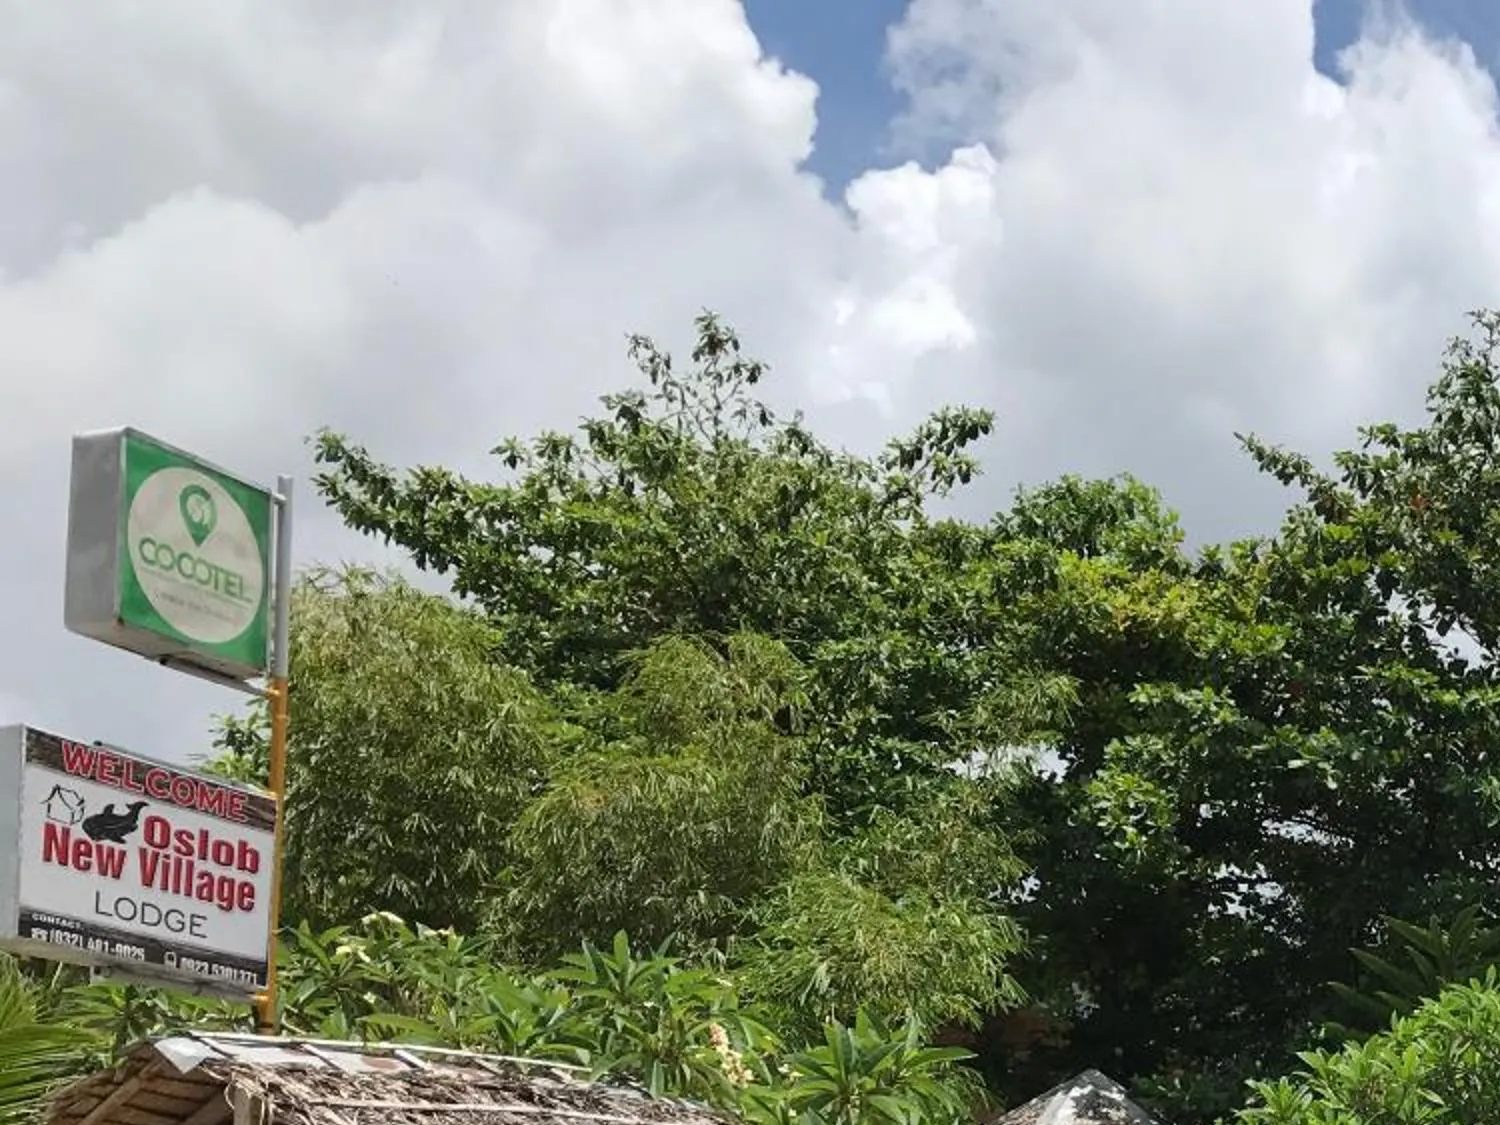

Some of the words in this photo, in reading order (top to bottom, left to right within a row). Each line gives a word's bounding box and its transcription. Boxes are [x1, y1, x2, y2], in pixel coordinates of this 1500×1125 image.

[138, 536, 254, 604] COCOTEL
[60, 740, 248, 822] WELCOME
[42, 822, 127, 880] New
[138, 847, 256, 912] Village
[143, 815, 260, 874] Oslob
[94, 890, 208, 938] LODGE
